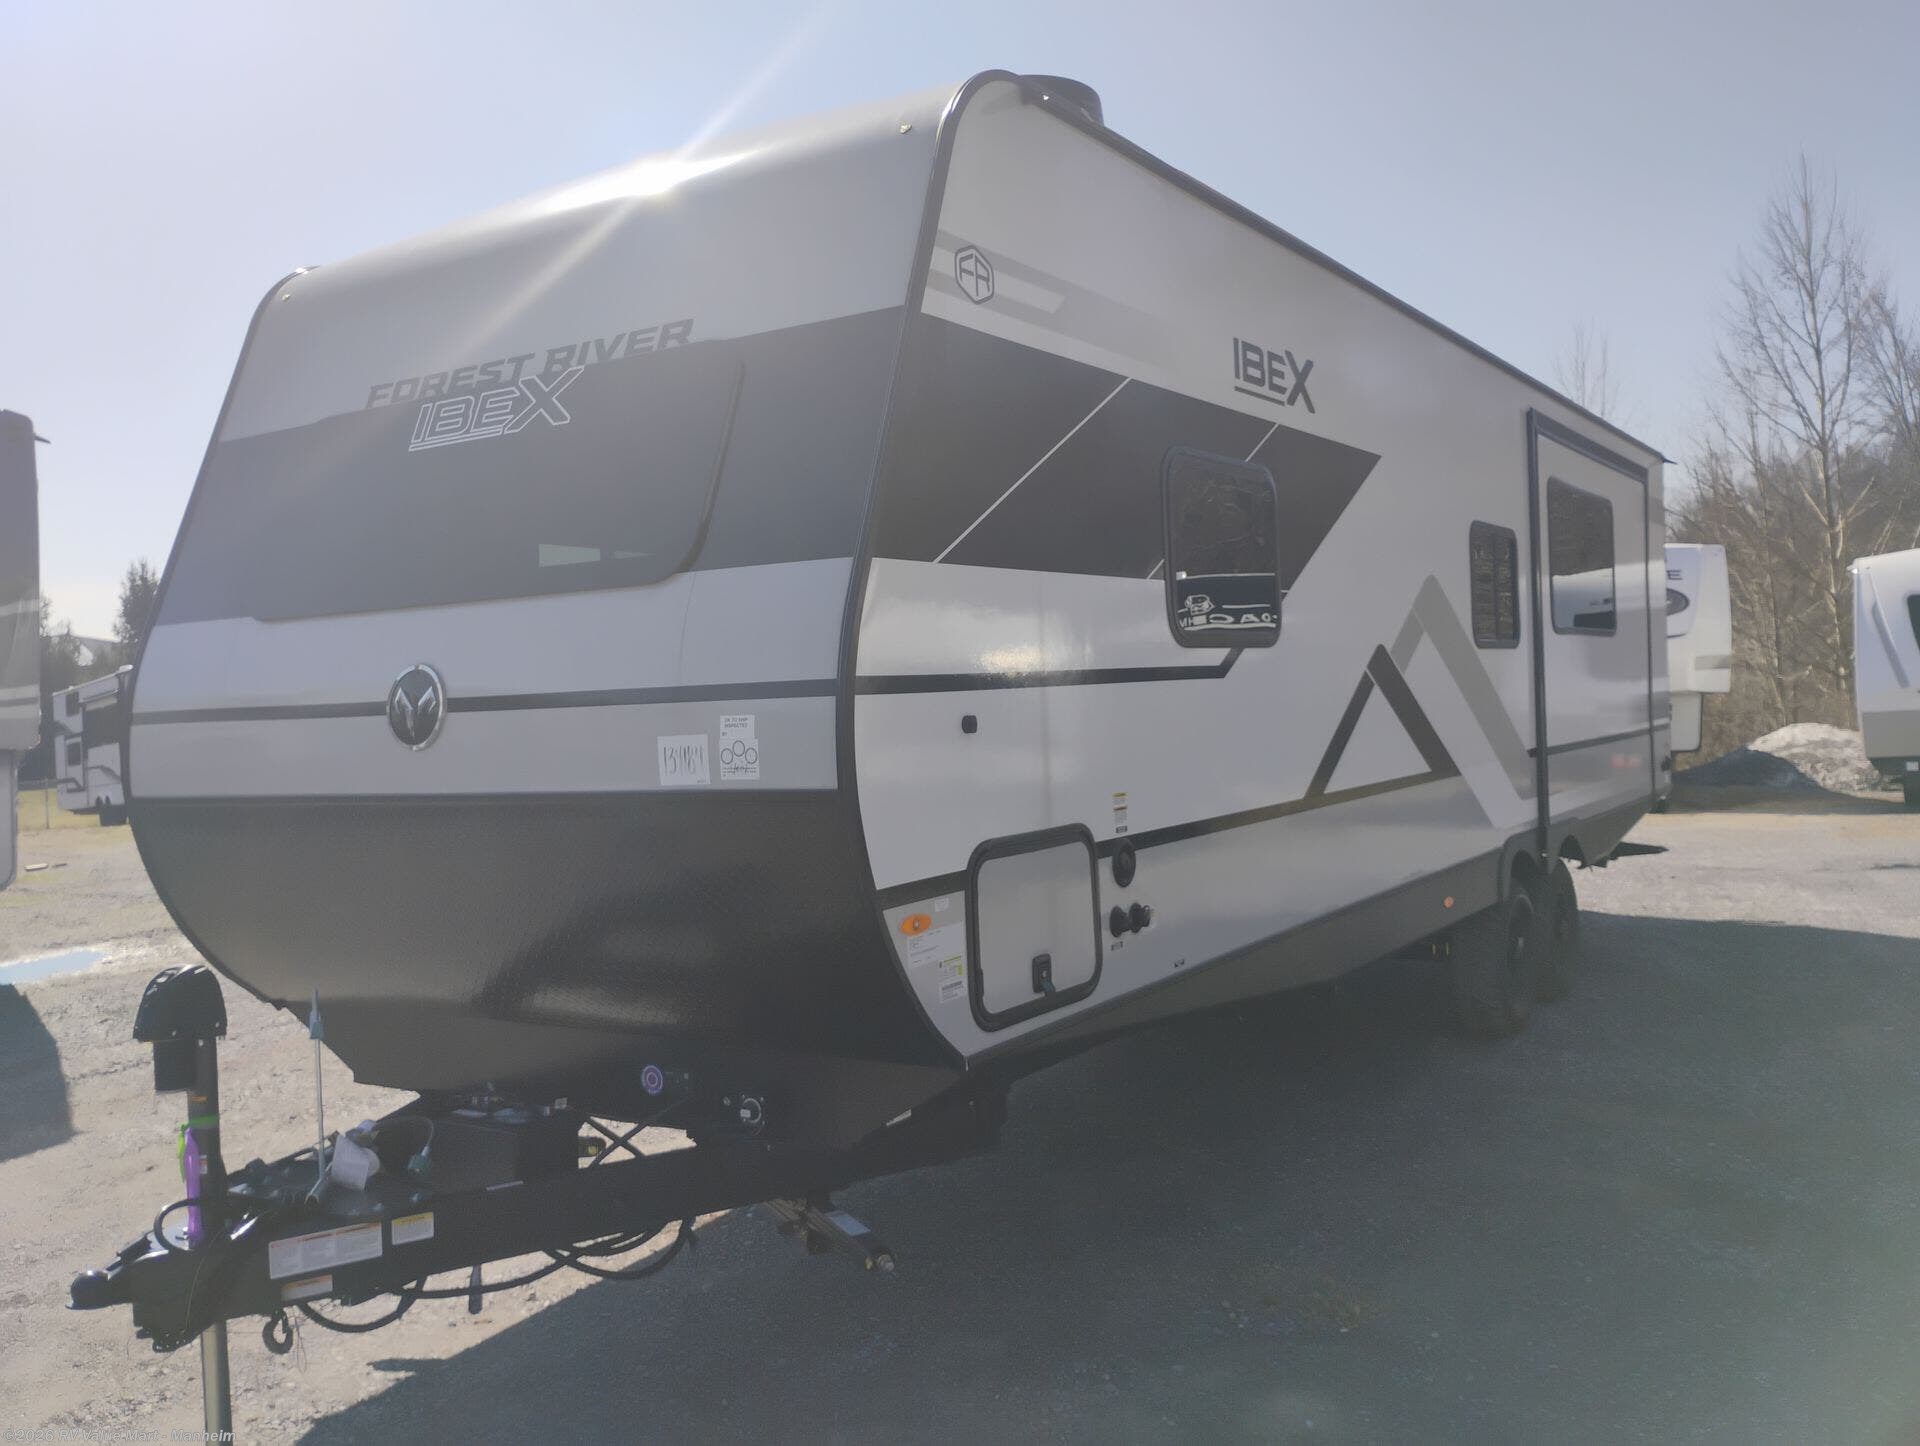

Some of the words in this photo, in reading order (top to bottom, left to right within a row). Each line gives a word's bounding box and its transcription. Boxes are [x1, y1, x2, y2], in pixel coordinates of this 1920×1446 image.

[365, 352, 536, 410] FOREST
[538, 318, 695, 378] RIVER
[1232, 337, 1316, 414] IBEX
[408, 365, 585, 451] IBEX
